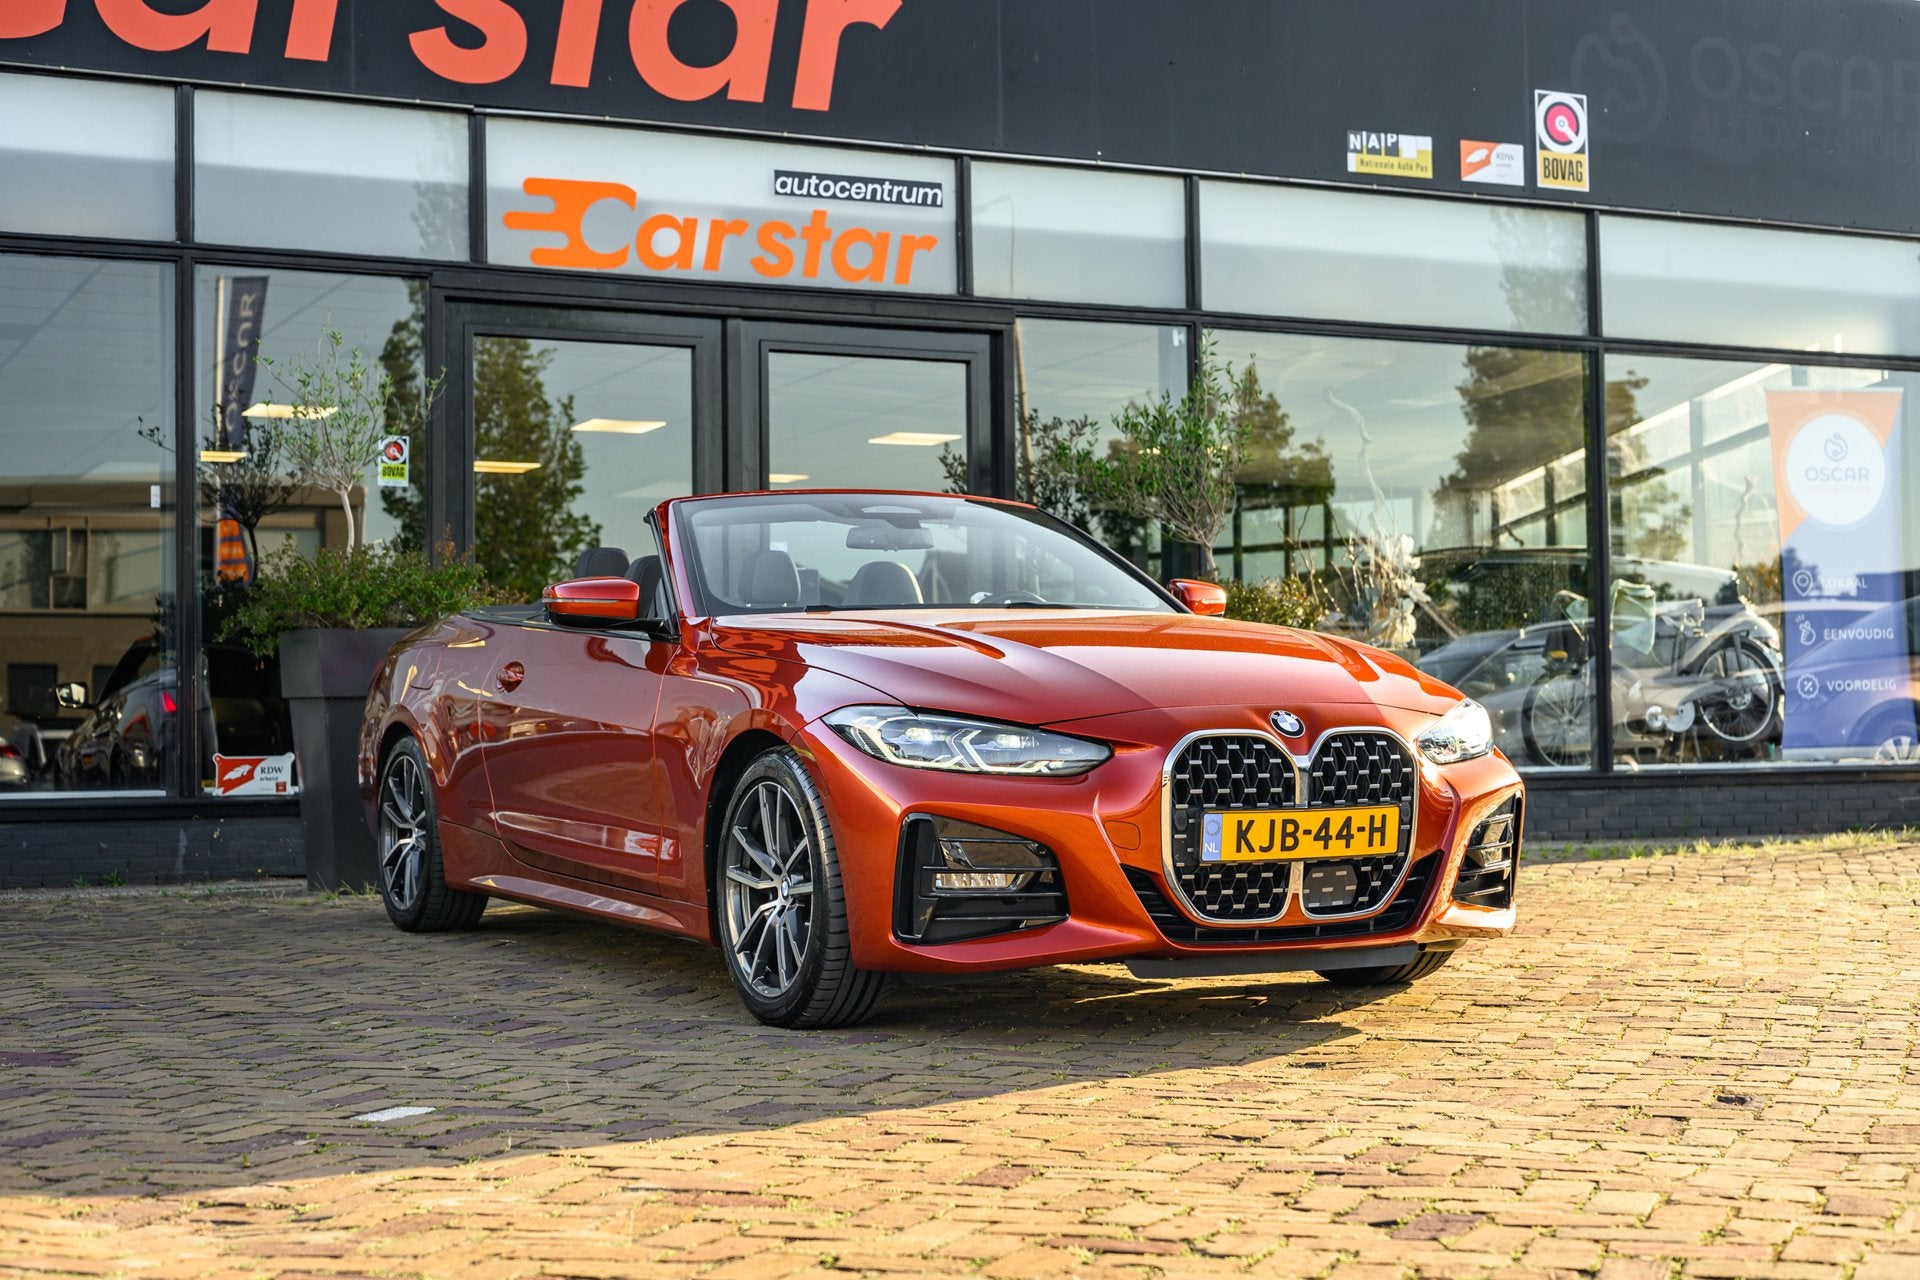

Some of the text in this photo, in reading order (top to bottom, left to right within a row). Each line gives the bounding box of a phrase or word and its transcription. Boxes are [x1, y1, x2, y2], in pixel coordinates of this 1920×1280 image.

[1360, 159, 1428, 172] Nationale Auto Pas
[1543, 157, 1583, 182] BOVAG
[775, 173, 942, 205] autocentrum
[503, 177, 938, 285] Carstar
[382, 465, 405, 478] BOVAG
[1804, 467, 1870, 482] OSCAR
[1824, 628, 1894, 640] EENVOUDIG
[1826, 679, 1897, 691] VOORDELIG
[260, 766, 284, 775] RDW
[1236, 814, 1387, 853] KJB-44-H
[1204, 841, 1219, 853] NL
